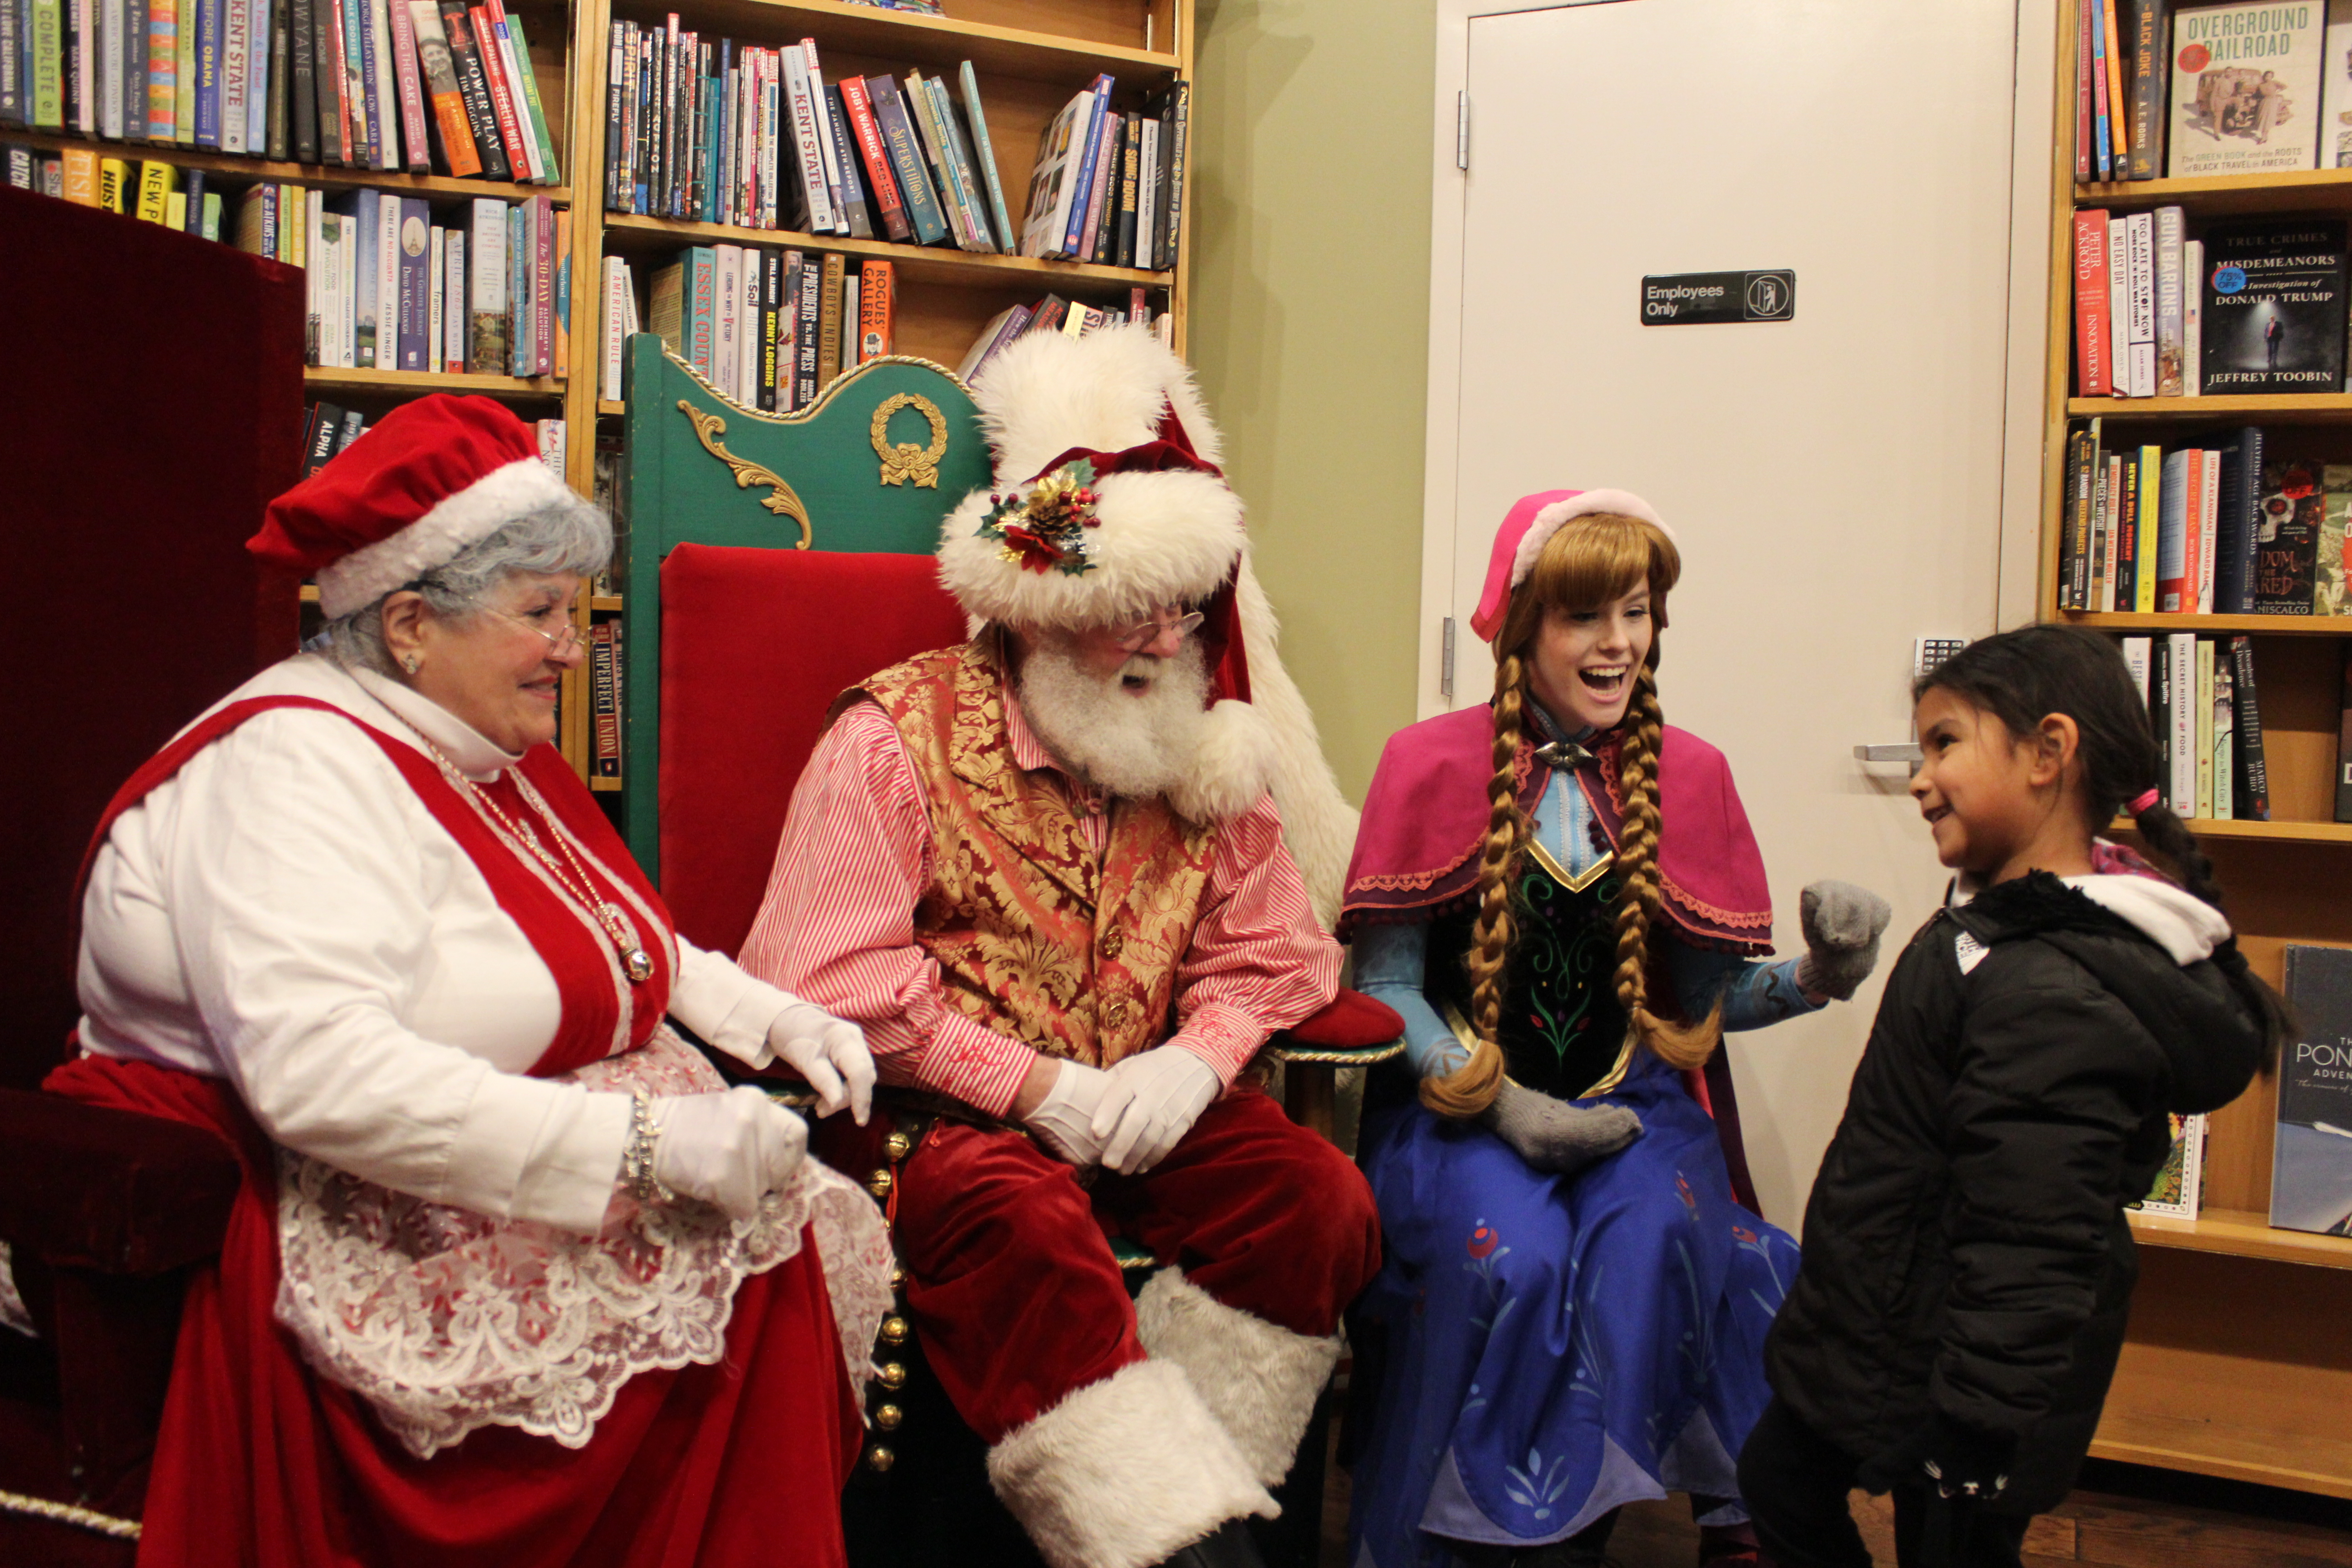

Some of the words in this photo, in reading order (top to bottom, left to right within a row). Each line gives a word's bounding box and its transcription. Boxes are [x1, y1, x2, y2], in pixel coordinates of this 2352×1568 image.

[230, 0, 245, 49] KENT
[396, 15, 410, 50] BRING
[498, 23, 507, 39] 2020
[2107, 11, 2117, 61] Fermentation
[2140, 11, 2153, 46] BLACK
[2188, 6, 2309, 39] OVERGROUND
[39, 10, 54, 93] COMPLETE
[349, 20, 358, 57] COOKIES
[203, 46, 213, 87] OBAMA
[402, 54, 413, 73] THE
[623, 32, 637, 91] SPIRIT
[2138, 49, 2152, 78] JOKE
[228, 52, 245, 107] STATE
[405, 76, 416, 106] CAKE
[523, 74, 536, 95] INSTANT
[459, 76, 470, 92] TIM
[465, 96, 482, 137] HIGGINS
[466, 57, 490, 109] POWER
[482, 116, 501, 150] PLAY
[485, 45, 501, 76] SPALDING
[495, 85, 518, 127] STEALTH
[507, 129, 522, 150] WAR
[611, 88, 620, 124] FIREFLY
[1177, 104, 1188, 120] DAVID
[925, 86, 942, 123] Underwater
[936, 124, 947, 147] Worlds
[794, 93, 812, 139] KENT
[803, 141, 823, 190] STATE
[848, 86, 866, 111] JOBY
[858, 113, 881, 160] WARRICK
[873, 161, 887, 181] RED
[882, 184, 896, 207] LINE
[1074, 119, 1086, 153] WEEKEND
[1102, 134, 1112, 157] CHOP
[2137, 122, 2146, 149] ROOKS
[10, 149, 30, 189] CATCH
[832, 113, 844, 147] JANUARY
[843, 165, 856, 195] REPORT
[983, 147, 995, 174] STICKING
[1068, 154, 1078, 181] SEWING
[1109, 142, 1119, 175] CHARLIE'S
[1124, 148, 1138, 180] SONIC
[2192, 163, 2219, 172] BLACK
[2221, 161, 2251, 170] TRAVEL
[2261, 158, 2298, 167] AMERICA
[146, 168, 164, 206] NEW
[990, 175, 999, 189] WITH
[994, 190, 1002, 203] YOU
[1093, 181, 1103, 207] CARRY
[1107, 176, 1116, 196] GOOD
[1121, 180, 1136, 212] BOOM
[1171, 180, 1182, 203] HISTORY
[263, 211, 274, 238] ATKINS
[1088, 208, 1099, 232] WATER
[1104, 197, 1113, 227] TONIGHT
[2113, 235, 2123, 247] NO
[2139, 217, 2147, 238] TOO
[2161, 213, 2178, 251] GUN
[2226, 236, 2265, 247] TRUE
[2270, 233, 2328, 245] CRIMES
[387, 240, 394, 250] NO
[454, 241, 463, 279] APRIL
[2078, 221, 2092, 280] ACKROYD
[2090, 231, 2102, 268] PETER
[2113, 249, 2124, 268] EASY
[2141, 269, 2148, 282] TO
[2216, 255, 2336, 270] MISDEMEANORS
[2220, 272, 2242, 281] 75%
[538, 259, 549, 304] 30-DAY
[696, 262, 712, 318] ESSEX
[825, 263, 838, 315] COWBOYS
[1647, 285, 1724, 300] Employees
[2114, 271, 2125, 285] DAY
[2161, 252, 2177, 317] BARONS
[2218, 281, 2237, 289] OFF
[2248, 282, 2309, 290] Investigation
[2310, 279, 2323, 288] of
[432, 291, 442, 325] framers
[454, 283, 463, 310] 1865
[612, 275, 621, 333] AMERICAN
[747, 284, 759, 307] Soil
[801, 272, 818, 321] PRESIDENTS
[862, 268, 874, 327] GALLERY
[875, 270, 887, 329] ROGUES'
[1646, 302, 1678, 317] Only
[2215, 294, 2276, 305] DONALD
[2281, 292, 2333, 303] TRUMP
[766, 311, 776, 344] KENNY
[2141, 315, 2149, 337] NOW
[611, 337, 620, 365] RULE
[823, 323, 837, 361] INDIES
[2087, 314, 2099, 377] INNOVATION
[764, 346, 774, 387] LOGGINS
[801, 347, 815, 372] PRESS
[2207, 372, 2269, 387] JEFFREY
[2273, 372, 2333, 382] TOOBIN
[314, 421, 335, 457] ALPHA
[554, 448, 562, 475] THIS
[2080, 466, 2090, 474] 52
[2209, 471, 2216, 481] OF
[2079, 474, 2089, 499] RANDOM
[2097, 478, 2107, 501] PIECES
[2109, 465, 2118, 497] DEMOCRACY
[2128, 463, 2136, 491] NEVER
[2252, 479, 2260, 497] AGE
[2077, 500, 2088, 526] WEEKEND
[2096, 506, 2106, 531] WEIGHT
[2108, 498, 2117, 515] RULES
[2126, 501, 2135, 523] DULL
[2206, 489, 2215, 531] KLANSMAN
[2189, 512, 2197, 533] MAN
[2249, 500, 2259, 555] BACKWARDS
[2076, 527, 2086, 554] PROJECTS
[2125, 525, 2134, 562] MOMENT
[2204, 538, 2212, 569] EDWARD
[2235, 650, 2245, 688] Decadence
[2244, 649, 2253, 677] Decades
[595, 647, 613, 710] IMPERFECT
[599, 719, 616, 754] UNION
[2247, 764, 2256, 791] RUBIO
[2255, 760, 2266, 793] MARCO
